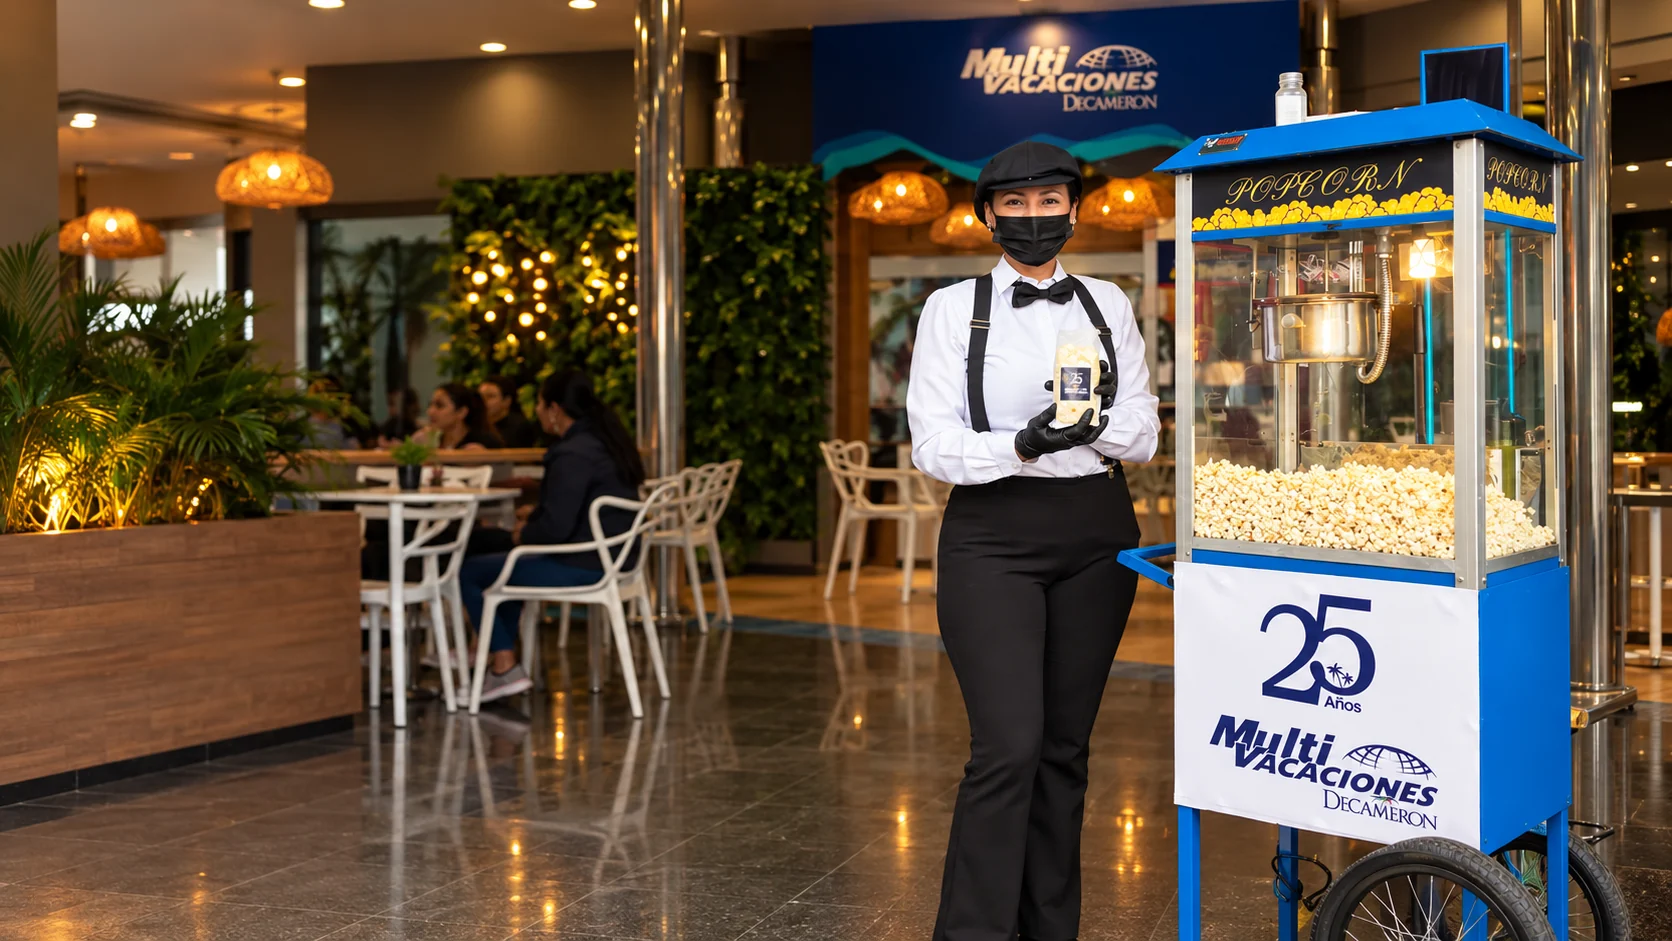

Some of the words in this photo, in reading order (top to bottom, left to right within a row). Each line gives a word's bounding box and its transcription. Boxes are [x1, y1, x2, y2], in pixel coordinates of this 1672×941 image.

[961, 45, 1070, 80] Multi
[983, 71, 1159, 95] VACACIONES
[1063, 93, 1158, 112] DECAMERON
[1225, 157, 1424, 205] POPCORN
[1486, 156, 1552, 194] POPCORN
[1070, 373, 1083, 385] 25
[1260, 593, 1376, 706] 25
[1324, 696, 1362, 714] Años
[1210, 714, 1336, 767] Multi
[1234, 743, 1438, 807] VACACIONES
[1323, 789, 1438, 831] DECAMERON
